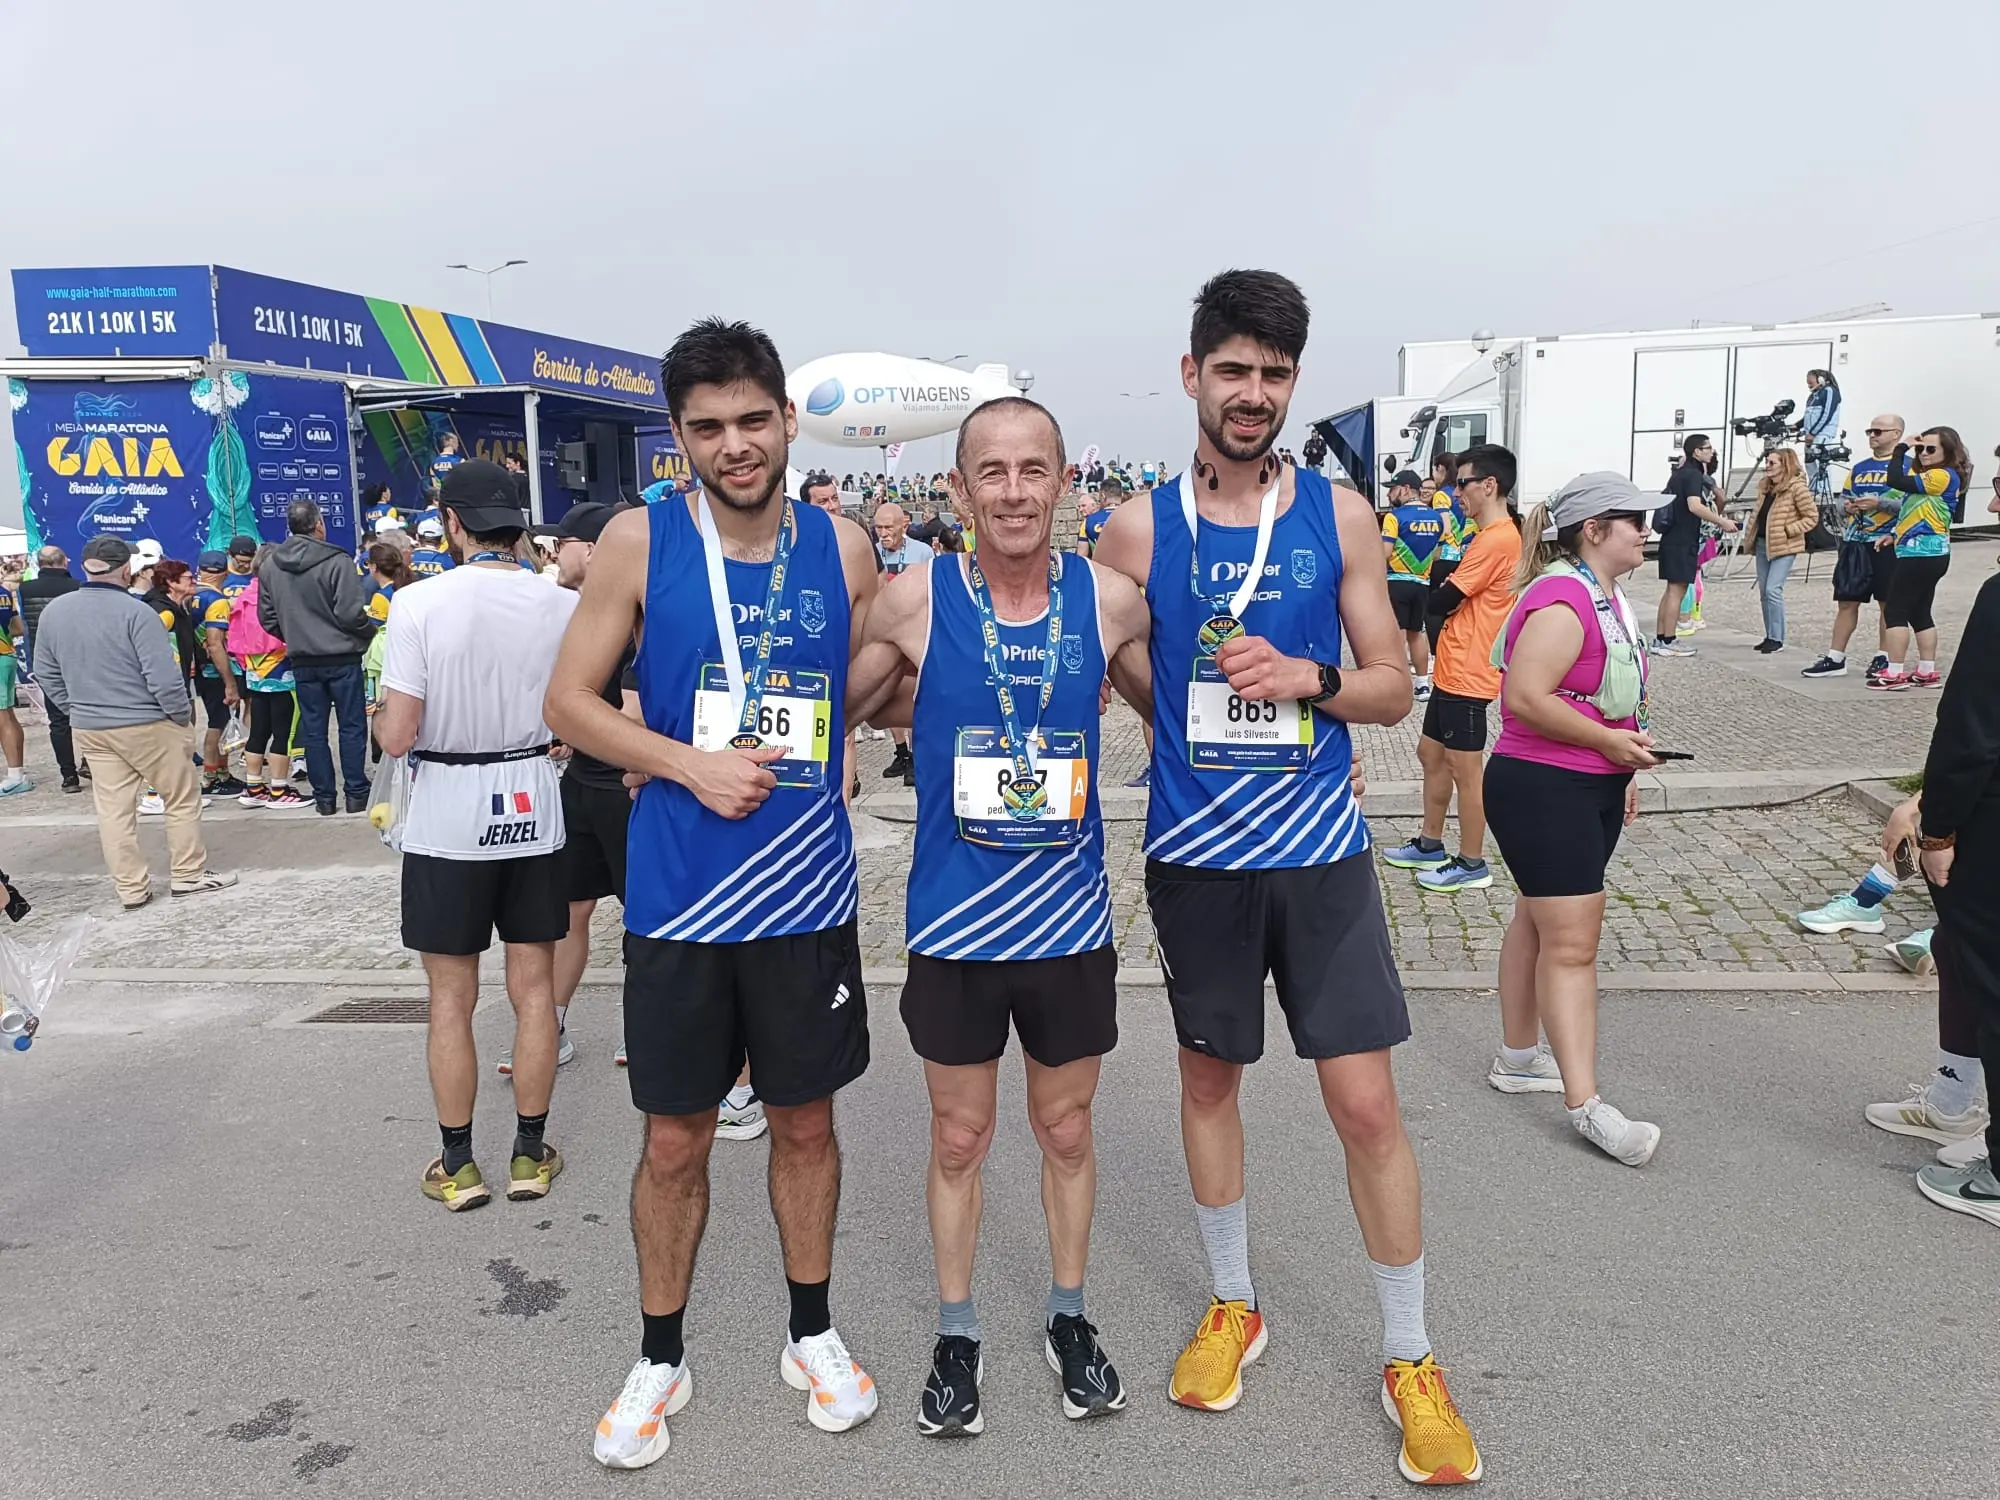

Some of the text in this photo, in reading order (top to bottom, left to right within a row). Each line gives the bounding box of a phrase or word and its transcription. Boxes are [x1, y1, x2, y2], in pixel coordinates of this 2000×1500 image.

[46, 286, 177, 301] www.gaia-half-marathon.com
[47, 311, 84, 334] 21K
[100, 311, 136, 333] 10K
[152, 310, 177, 333] 5K
[254, 306, 288, 336] 21K
[301, 314, 332, 342] 10K
[343, 321, 364, 348] 5K
[533, 347, 655, 396] Corrida do Atlântico
[903, 402, 969, 413] Viajamos Juntos
[306, 430, 332, 441] GAIA
[47, 437, 185, 478] GAIA
[68, 481, 168, 496] Corrida do Atlântico
[93, 513, 137, 525] Planicare
[1410, 521, 1440, 533] GAIA
[772, 564, 784, 592] GAIA
[1217, 562, 1281, 579] Per
[984, 620, 998, 649] GAIA
[1050, 616, 1060, 644] GAIA
[1210, 620, 1235, 629] GAIA
[758, 631, 772, 660] GAIA
[1010, 645, 1046, 662] Prife
[999, 687, 1013, 716] GAIA
[1227, 694, 1278, 723] 865
[744, 699, 758, 727] GAIA
[757, 705, 791, 737] 66
[815, 717, 826, 738] B
[1243, 728, 1280, 739] Silvestre
[734, 738, 758, 746] GAIA
[1199, 750, 1219, 758] GAIA
[997, 768, 1048, 797] 87
[1013, 783, 1037, 791] GAIA
[1073, 776, 1085, 797] A
[478, 820, 519, 847] JERZEL
[968, 825, 988, 834] GAIA
